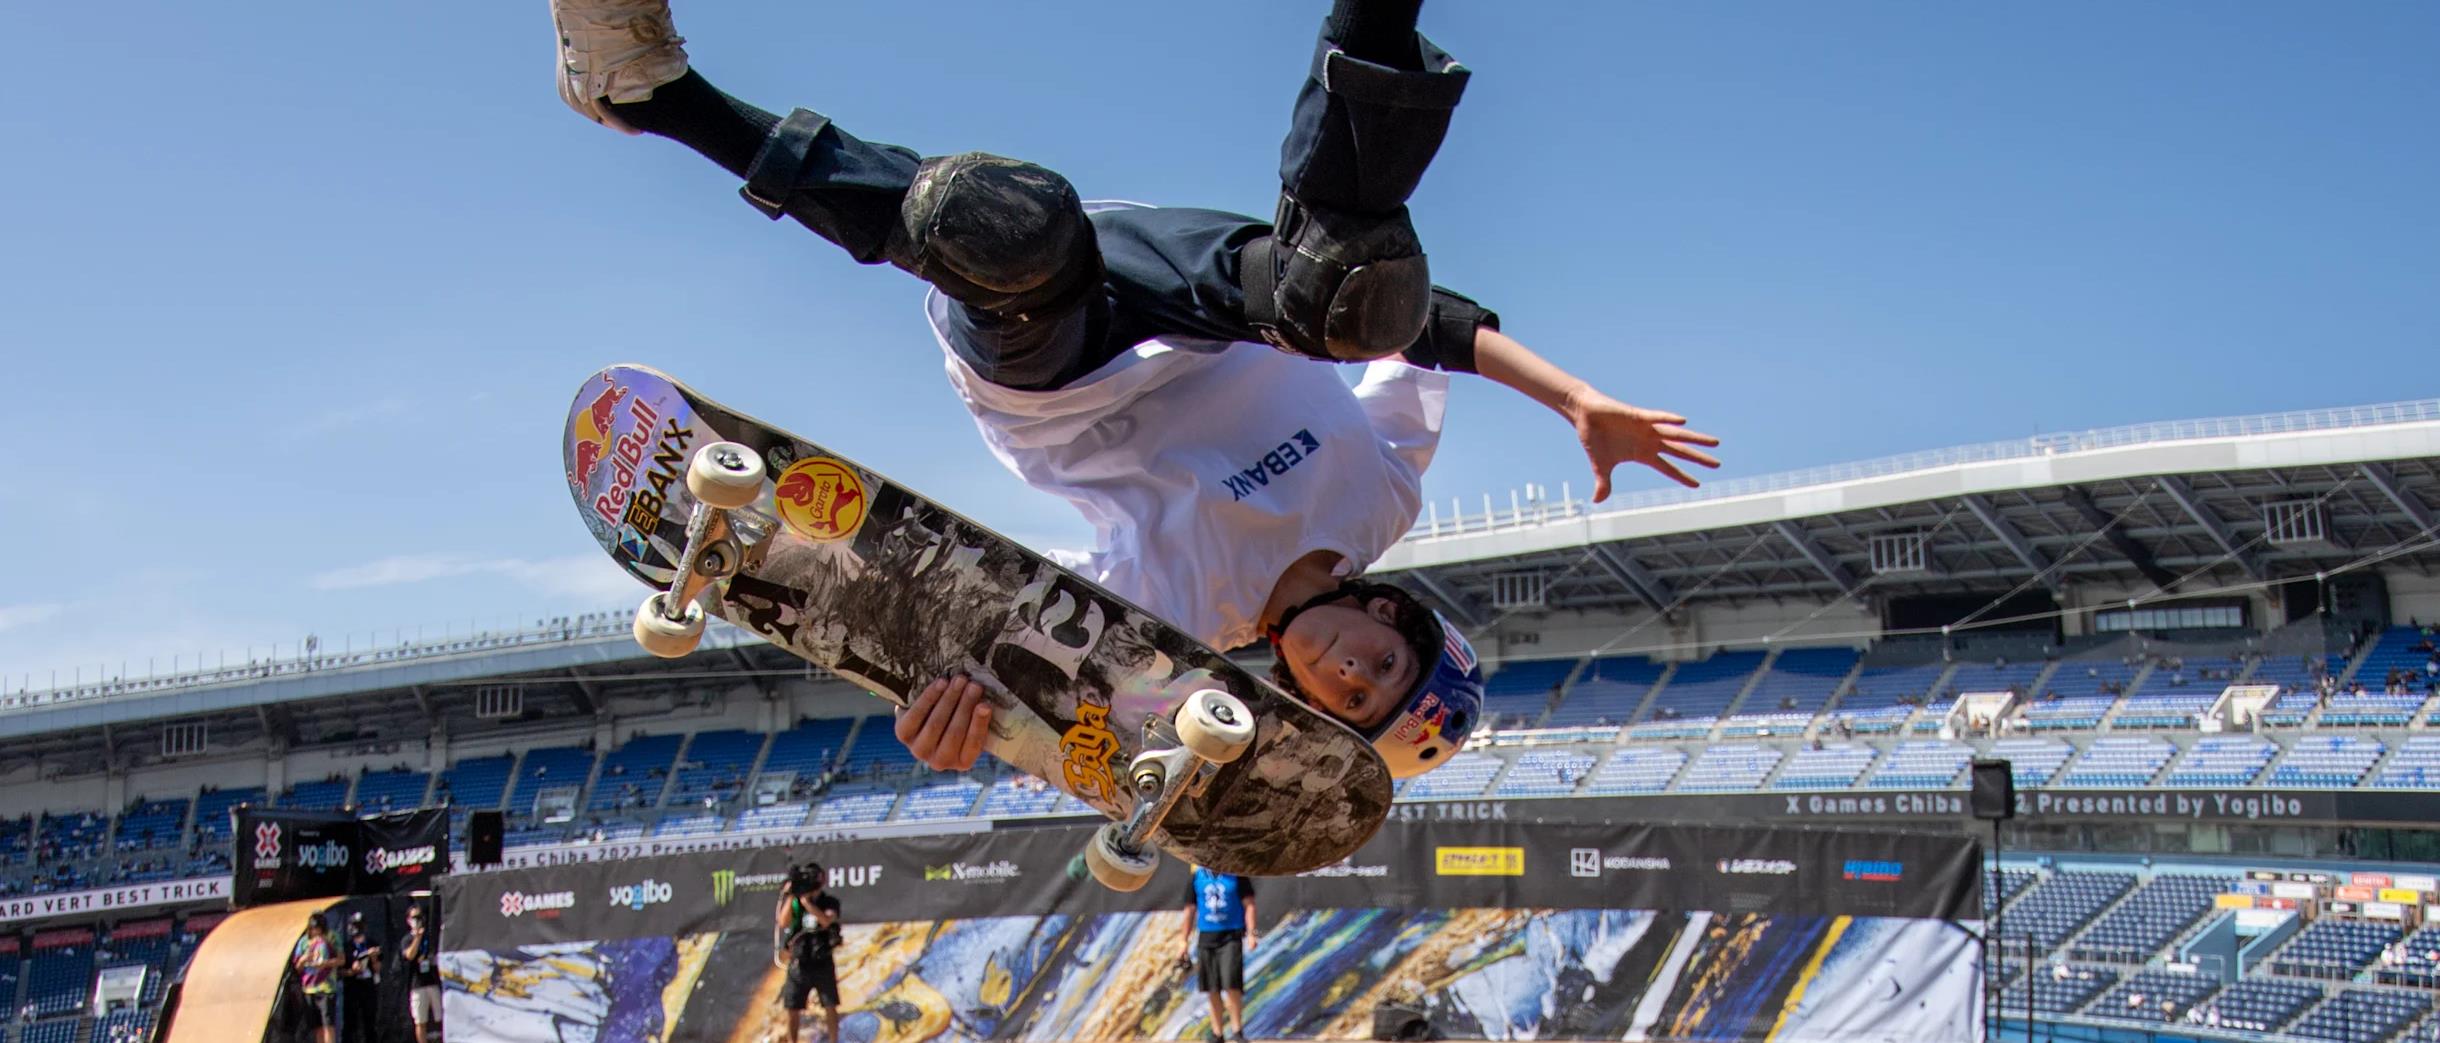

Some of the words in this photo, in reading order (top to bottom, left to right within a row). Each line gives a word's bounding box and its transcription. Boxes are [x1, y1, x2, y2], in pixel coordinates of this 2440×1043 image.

[627, 417, 694, 537] EBANX
[1222, 442, 1304, 502] EBANX
[810, 481, 832, 519] Garoto
[1059, 699, 1121, 807] Saga
[1436, 802, 1508, 820] TRICK
[1786, 795, 1800, 814] X
[1809, 795, 1887, 814] Games
[1895, 794, 1963, 814] Chiba
[2037, 794, 2167, 814] Presented
[2177, 794, 2204, 818] by
[2214, 793, 2303, 819] Yogibo
[299, 840, 349, 873] yogibo
[536, 849, 589, 866] Chiba
[828, 865, 884, 888] HUF
[44, 894, 93, 912] VERT
[103, 888, 150, 907] BEST
[161, 881, 220, 900] TRICK
[523, 890, 575, 912] GAMES
[609, 878, 673, 911] yogibo
